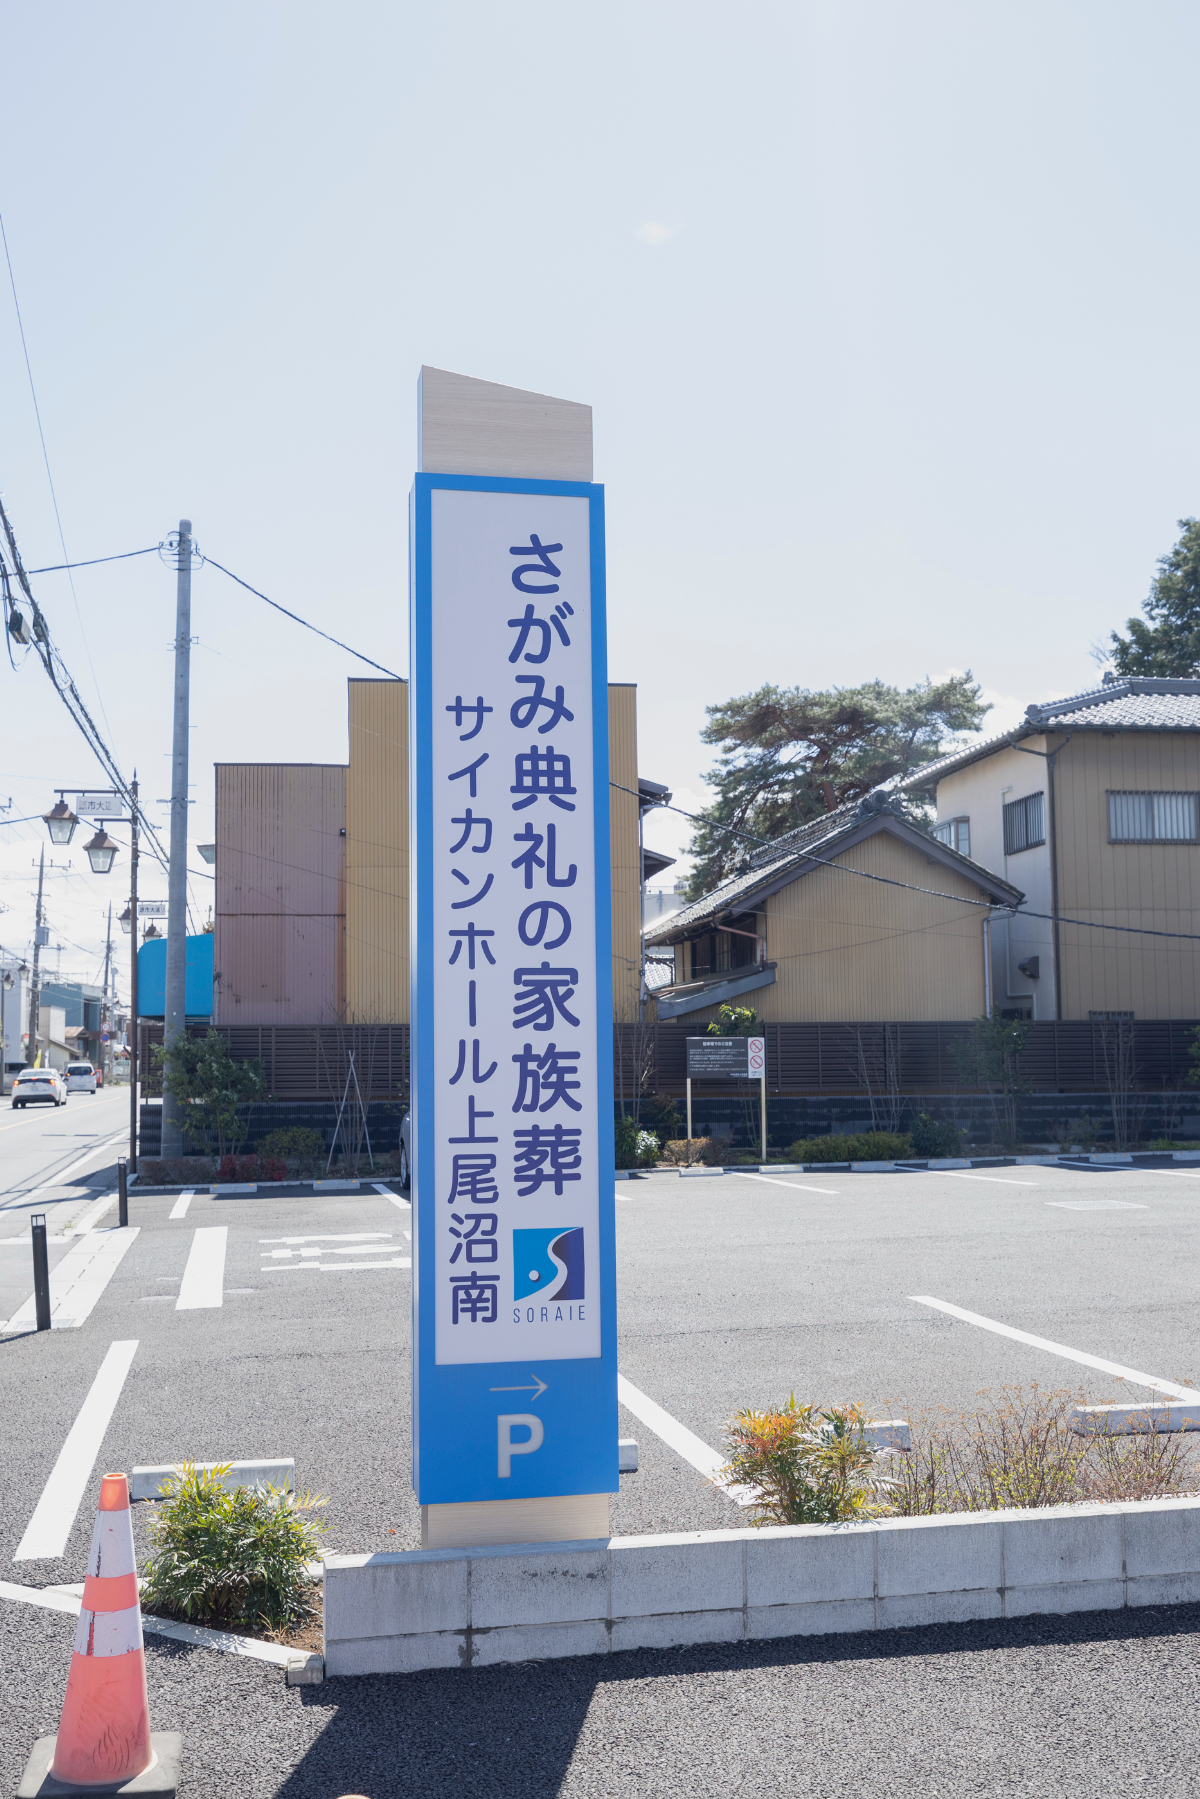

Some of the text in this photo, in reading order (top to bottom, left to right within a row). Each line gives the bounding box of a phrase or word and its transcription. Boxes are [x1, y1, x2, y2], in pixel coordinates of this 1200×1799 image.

[445, 695, 500, 1325] サイカンホール上尾沼南
[507, 533, 582, 1196] さがみ典礼の家族葬
[497, 1413, 544, 1479] P
[513, 1305, 587, 1323] SORAIE
